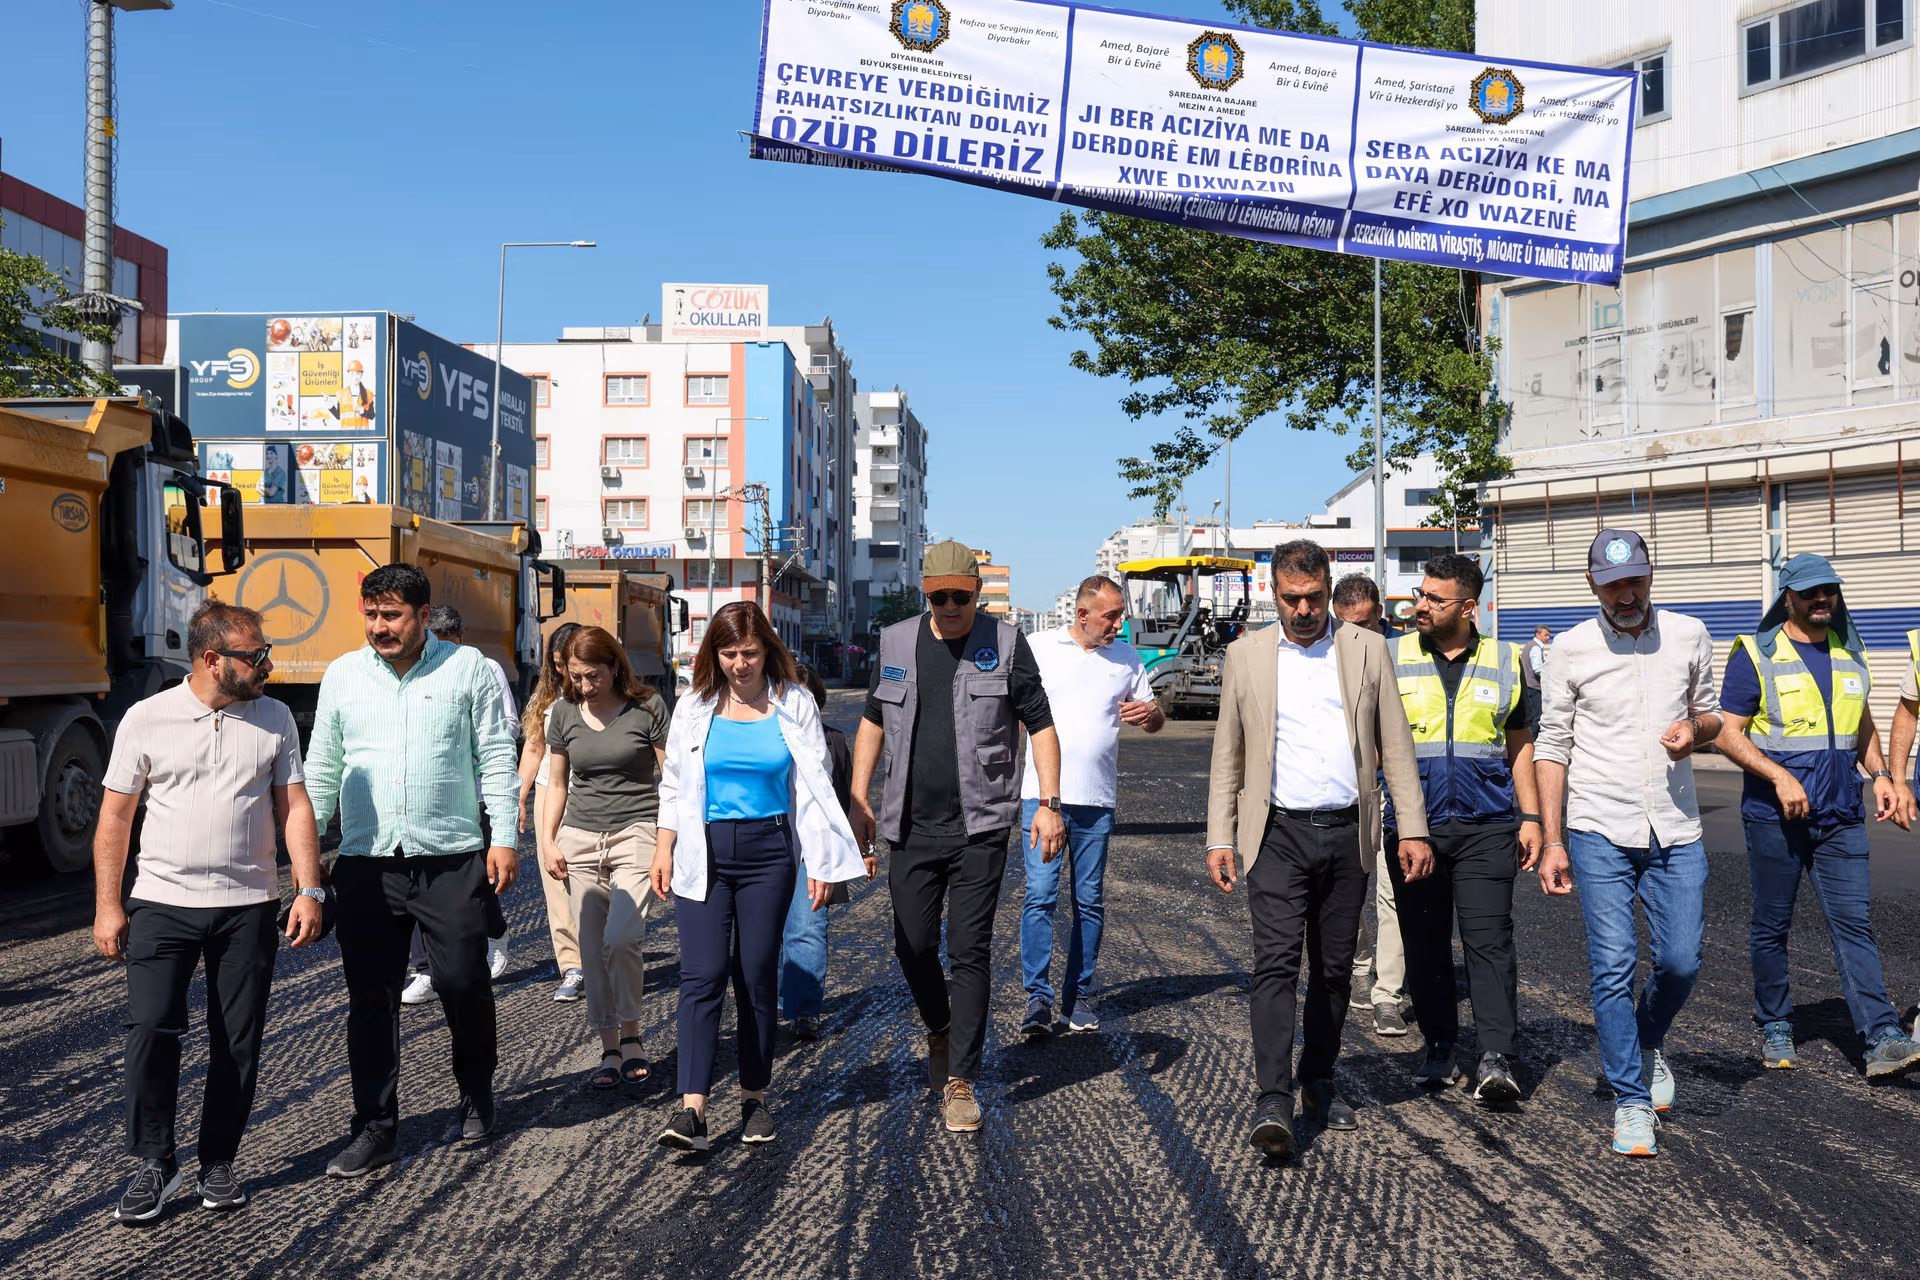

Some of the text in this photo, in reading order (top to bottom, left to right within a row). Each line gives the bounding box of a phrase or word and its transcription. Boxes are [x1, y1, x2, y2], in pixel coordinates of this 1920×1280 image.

[807, 7, 851, 21] Diyarbakır
[960, 18, 1059, 39] Hafıza ve Sevginin Kenti,
[987, 33, 1031, 46] Diyarbakır
[1100, 39, 1170, 58] Amed, Bajarê
[890, 52, 944, 67] DİYARBAKIR
[1107, 55, 1161, 71] Bir û Evînê
[860, 58, 972, 82] BÜYÜKŞEHİR BELEDİYESİ
[1269, 61, 1337, 80] Amed, Bajarê
[777, 62, 1050, 116] ÇEVREYE VERDİĞİMİZ
[1276, 77, 1329, 92] Bir û Evînê
[1374, 77, 1455, 95] Amed, Şaristanê
[1169, 90, 1258, 108] ŞAREDARİYA BAJARÊ
[1369, 90, 1458, 112] Vîr û Hezkerdişî yo
[1539, 95, 1568, 108] Amed,
[776, 89, 1047, 138] RAHATSIZLIKTAN DOLAYI
[1178, 101, 1246, 117] MEZİN A AMEDÊ
[1078, 104, 1330, 153] JI BER ACIZÎYA ME DA
[1607, 117, 1619, 127] yo
[771, 109, 1045, 175] ÖZÜR DİLERİZ
[1072, 130, 1343, 179] DERDORÊ EM LÊBORÎNA
[1366, 140, 1611, 182] SEBA ACIZÎYA KE MA
[1117, 165, 1296, 194] XWE DIXWAZIN
[1366, 165, 1610, 209] DAYA DERÛDORÎ, MA
[1227, 198, 1237, 223] Û
[1301, 210, 1335, 239] RÊYAN
[1393, 190, 1578, 232] EFÊ XO WAZENÊ
[1351, 220, 1395, 248] SEREKÎYA
[1487, 235, 1523, 264] MİQATE
[1524, 240, 1533, 265] Û
[1535, 242, 1570, 270] TAMÎRÊ
[1571, 248, 1614, 274] RAYÎRAN
[690, 287, 760, 310] ÇÖZÜM
[689, 312, 761, 327] OKULLARI
[1657, 314, 1699, 331] ÜRÜNLERİ
[190, 360, 247, 377] YFS
[302, 370, 340, 379] Güvenliği
[402, 356, 427, 384] YFS
[304, 377, 338, 386] Ürünleri
[439, 363, 489, 420] YFS
[500, 410, 524, 434] TEKSTİL
[612, 546, 671, 559] OKULLARI
[1338, 552, 1373, 560] ZÜCCACİYE
